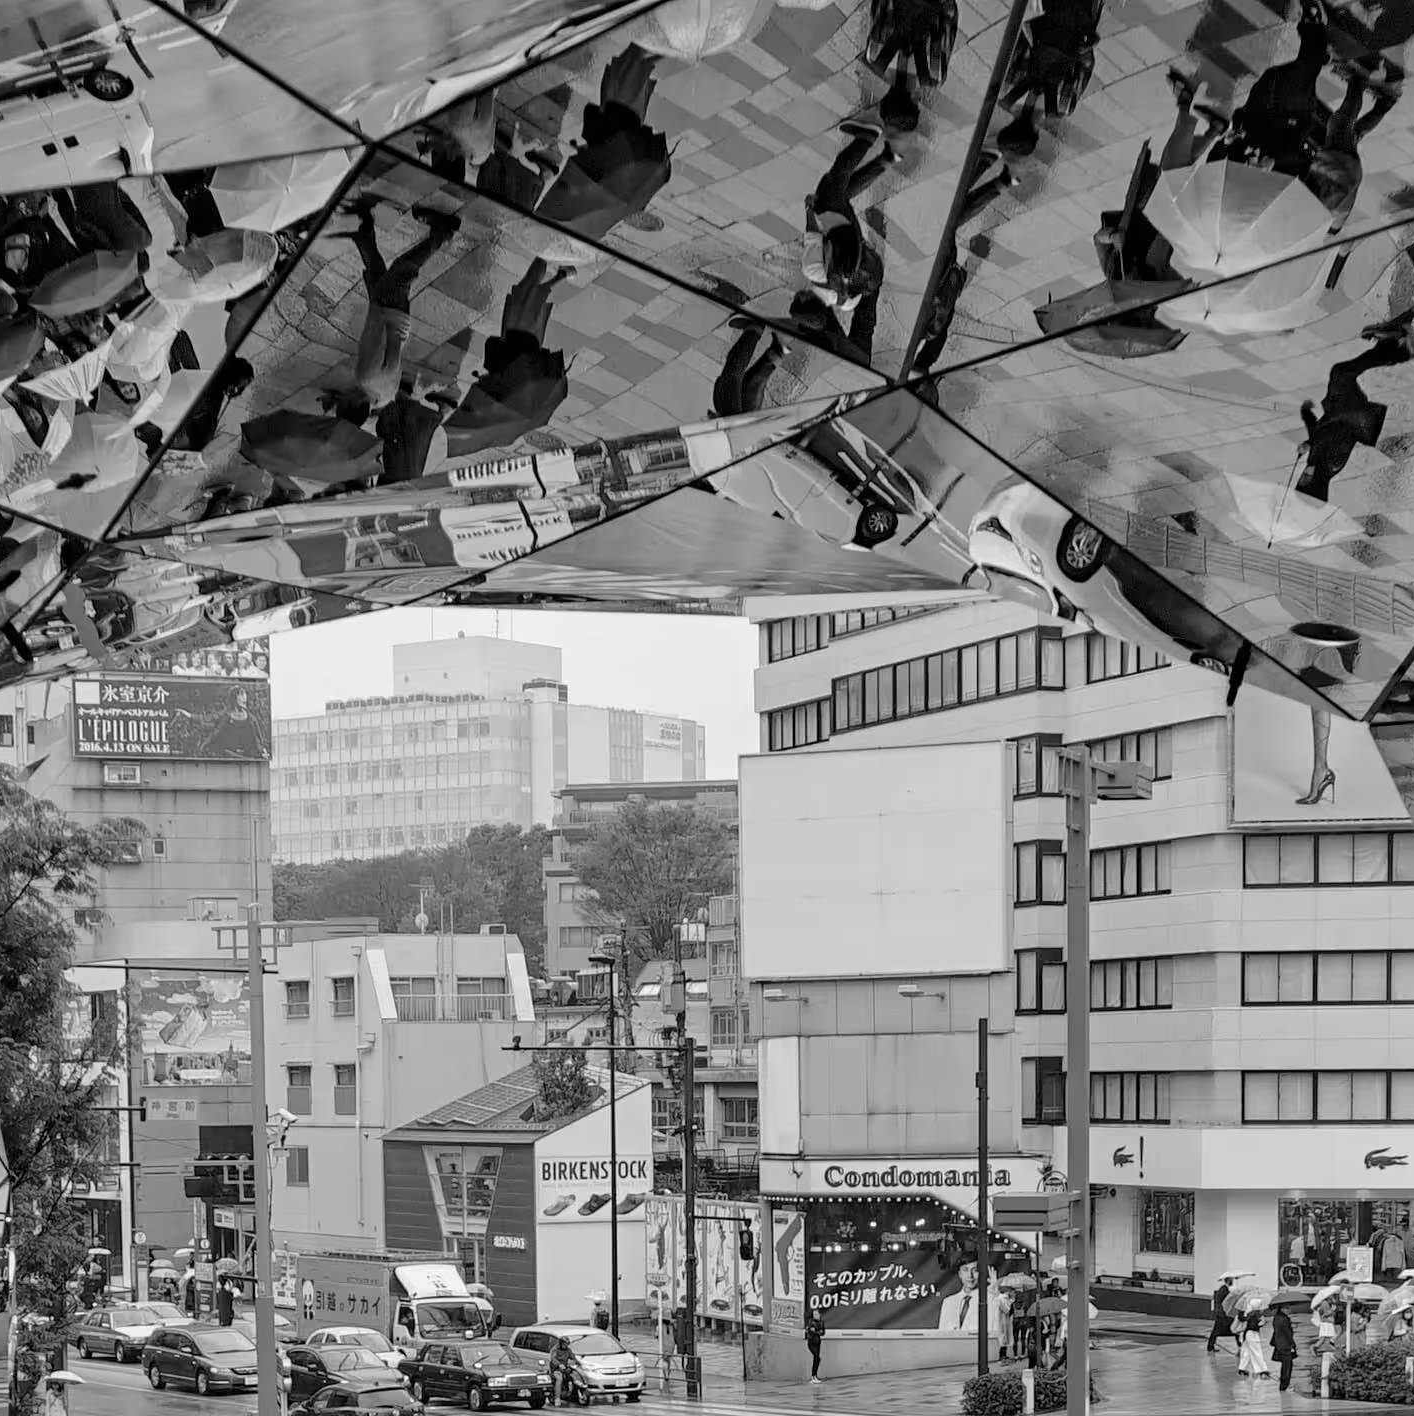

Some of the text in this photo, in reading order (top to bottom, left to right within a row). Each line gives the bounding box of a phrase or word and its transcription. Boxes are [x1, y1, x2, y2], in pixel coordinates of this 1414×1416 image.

[101, 684, 170, 705] 氷室京介
[78, 715, 170, 743] L'ÉPILOGUE
[78, 742, 171, 754] 2016.4.13 ON SALE
[812, 1263, 915, 1289] そこのカップル、
[809, 1283, 942, 1311] 0.01ミリ離れなさい。
